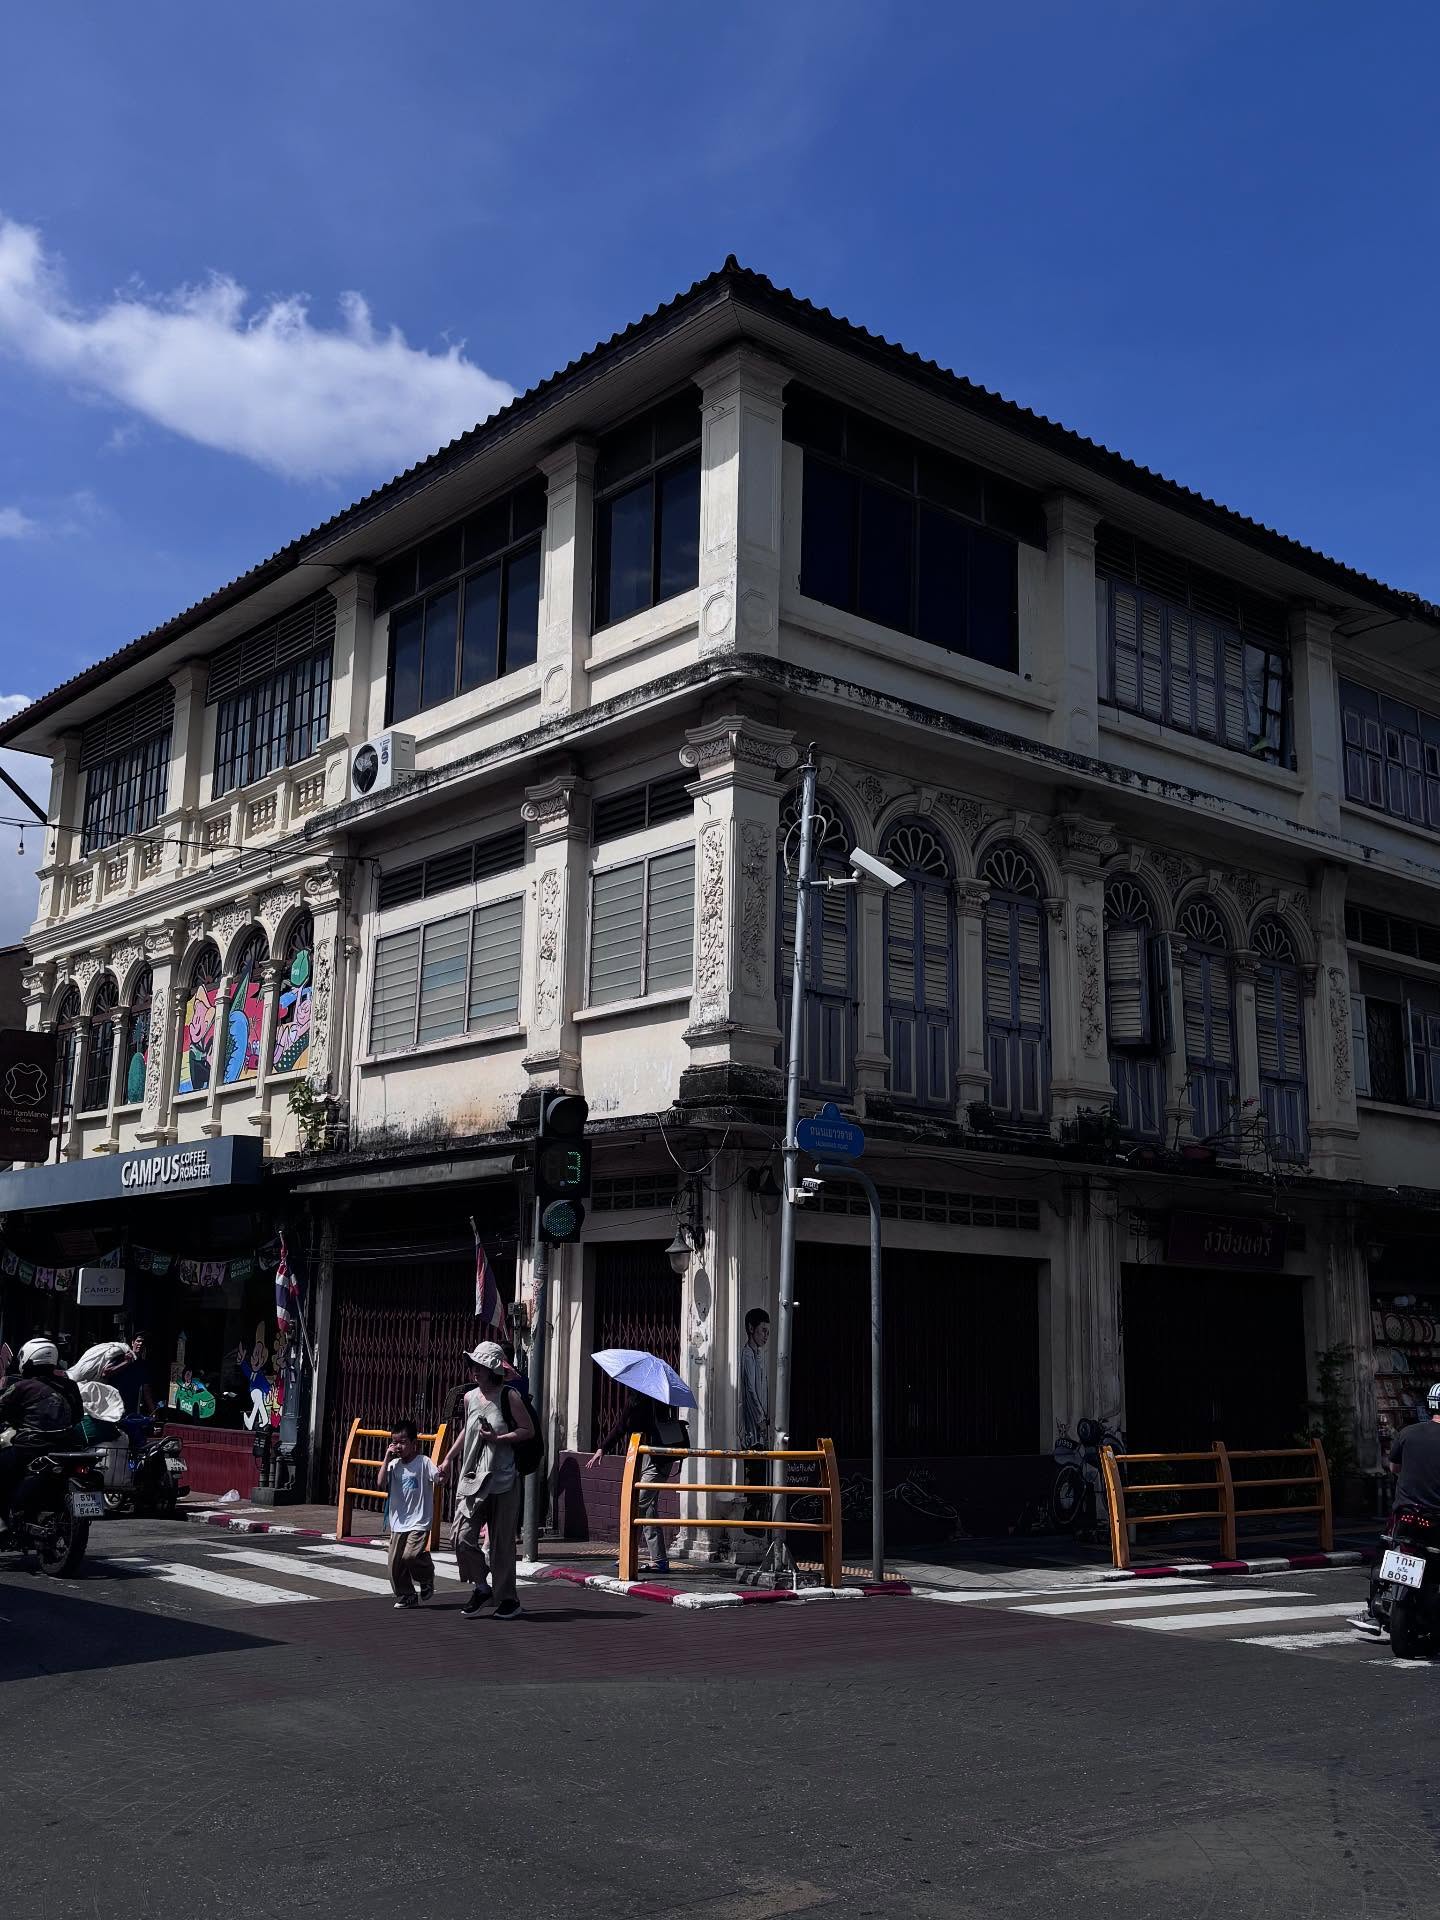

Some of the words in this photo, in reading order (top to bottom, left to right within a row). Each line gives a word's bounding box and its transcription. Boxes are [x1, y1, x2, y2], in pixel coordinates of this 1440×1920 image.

[180, 1150, 206, 1165] COFFEE
[121, 1154, 180, 1187] CAMPUS
[180, 1164, 210, 1180] ROASTER
[567, 1151, 581, 1185] 3
[1396, 1556, 1416, 1568] 1กม
[1387, 1570, 1414, 1585] 8091
